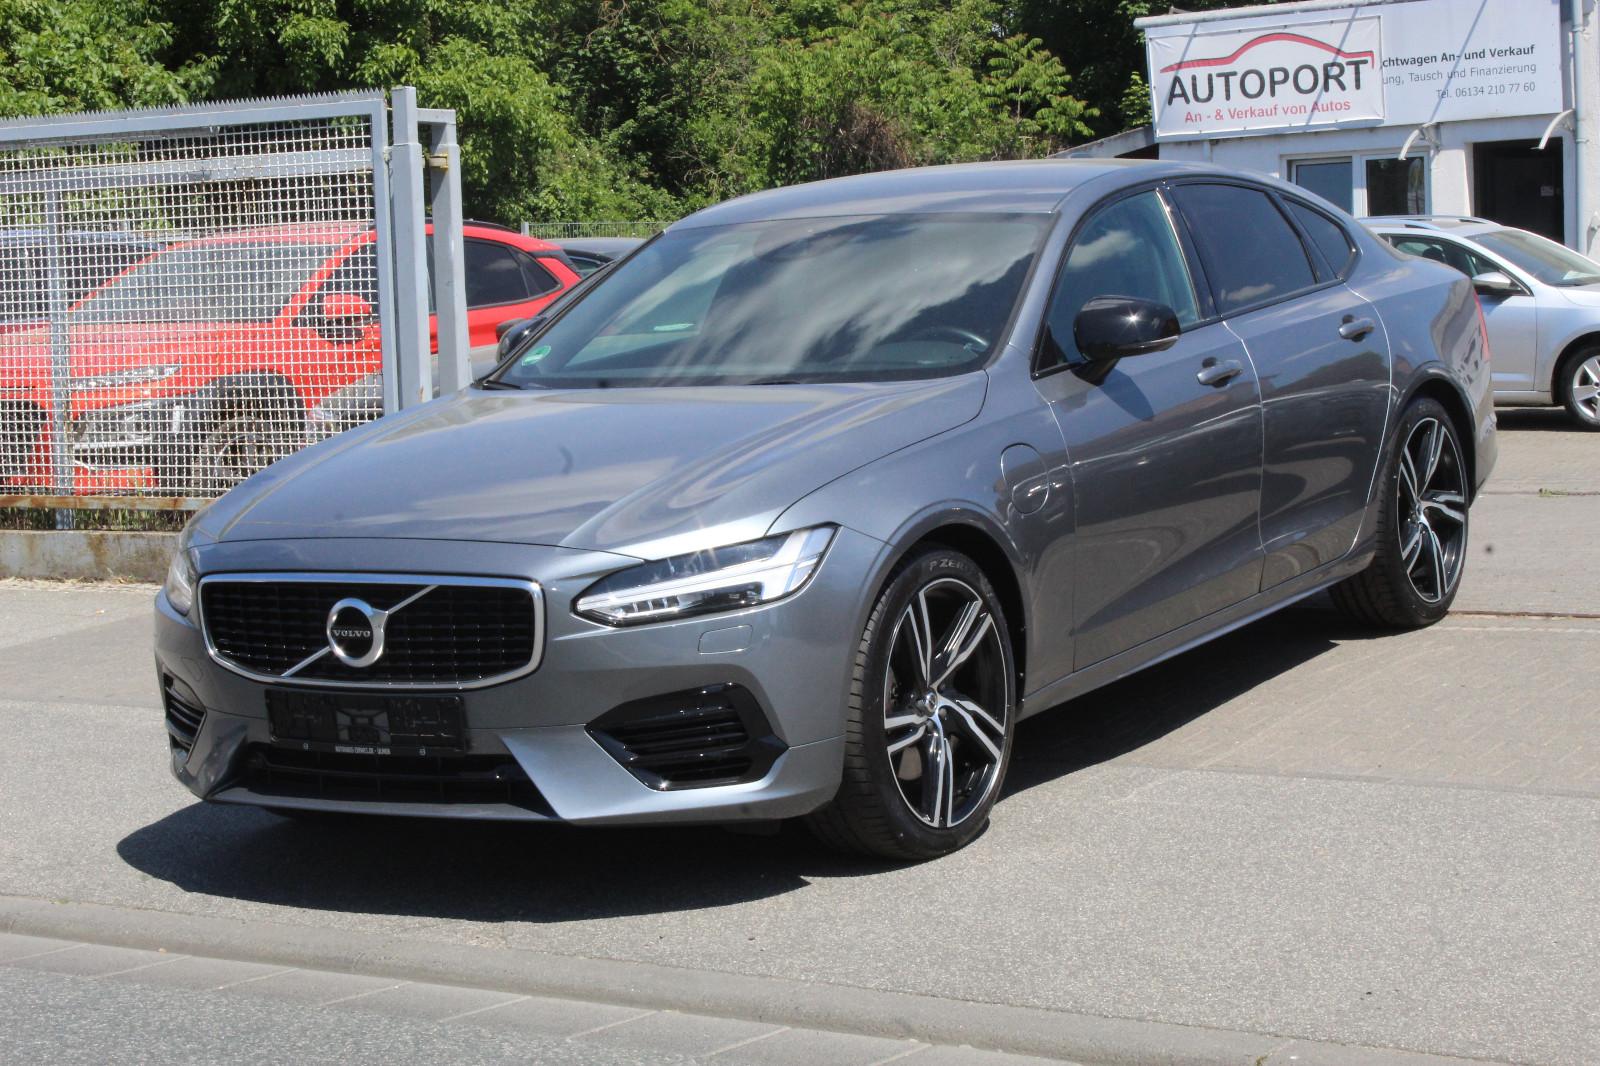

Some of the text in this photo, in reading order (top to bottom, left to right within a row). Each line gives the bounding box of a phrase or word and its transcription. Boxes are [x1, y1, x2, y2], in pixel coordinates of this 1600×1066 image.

[1382, 44, 1535, 68] chtwagen An- und Verkauf
[1408, 70, 1443, 82] Tausch
[1447, 67, 1466, 79] und
[1470, 63, 1537, 78] Finanzierung
[1167, 59, 1369, 106] AUTOPORT
[1436, 81, 1536, 99] Tel. 06134 210 77 60
[1214, 108, 1224, 120] &
[1227, 104, 1278, 120] Verkauf
[1282, 103, 1307, 115] von
[1311, 100, 1351, 113] Autos
[332, 629, 371, 638] VOLVO
